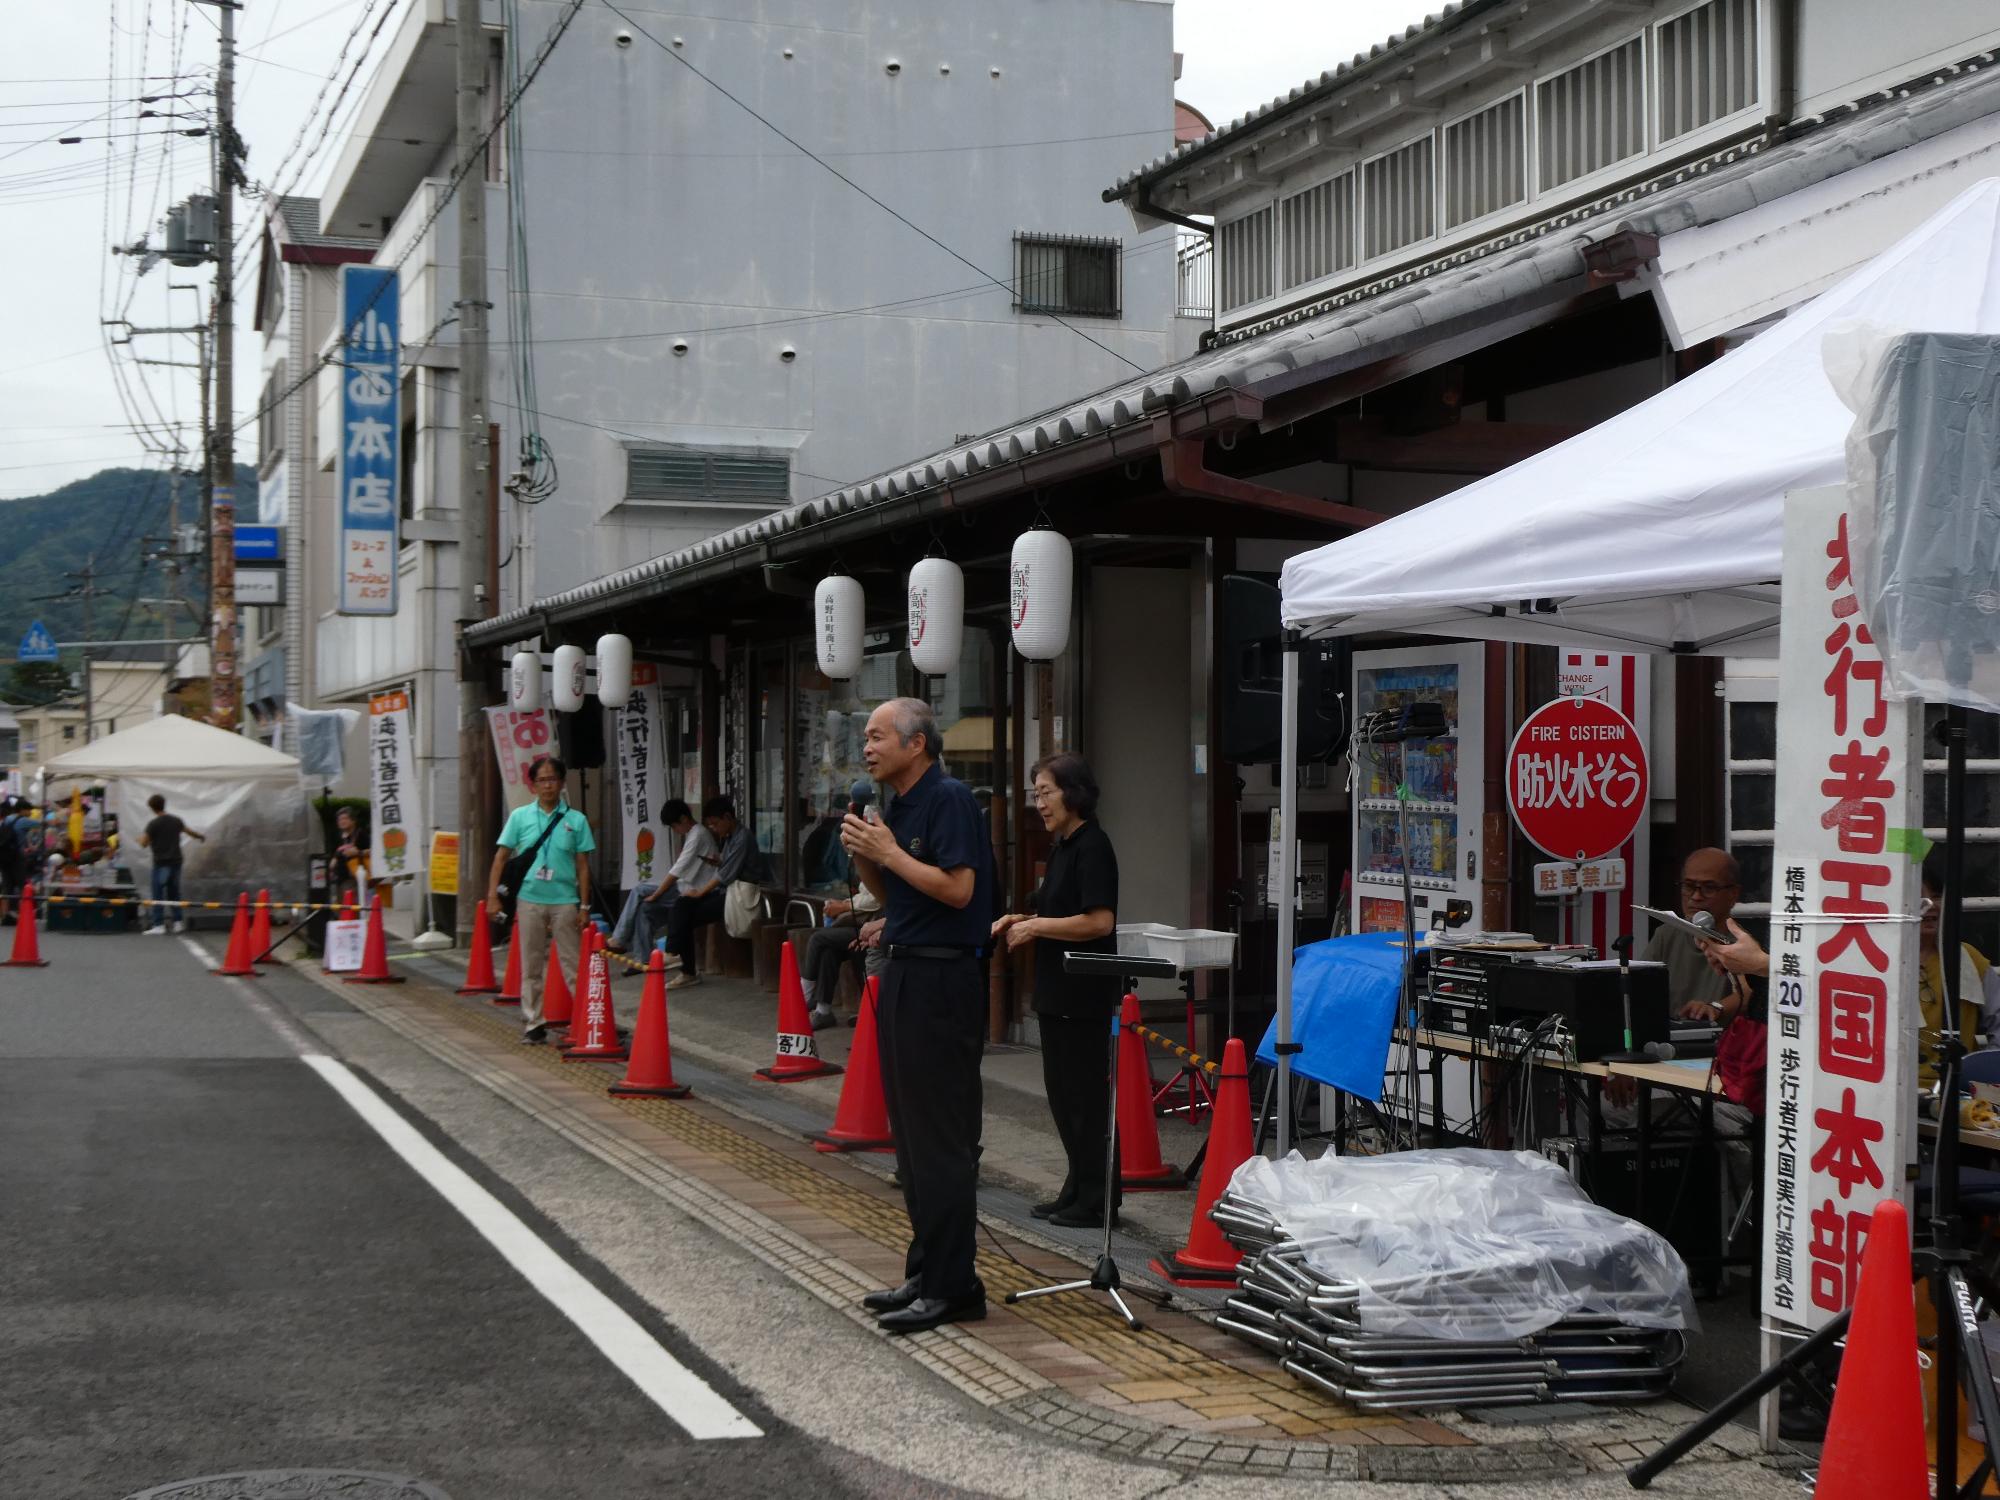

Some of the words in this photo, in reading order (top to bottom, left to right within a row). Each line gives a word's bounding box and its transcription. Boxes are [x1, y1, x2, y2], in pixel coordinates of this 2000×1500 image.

[911, 592, 921, 641] 高野口
[1012, 568, 1023, 621] 高野口
[824, 594, 836, 663] 高野口町商工会
[1531, 726, 1561, 742] FIRE
[1569, 725, 1625, 741] CISTERN
[1516, 751, 1642, 809] 防火水そう
[1539, 864, 1623, 892] 駐車禁止
[1783, 865, 1806, 945] 橋本市
[585, 953, 606, 1049] 横断禁止
[1776, 951, 1804, 1039] 第20回
[1773, 1046, 1801, 1311] 歩行者天国実行委員会
[1954, 1280, 1979, 1333] FUJITA
